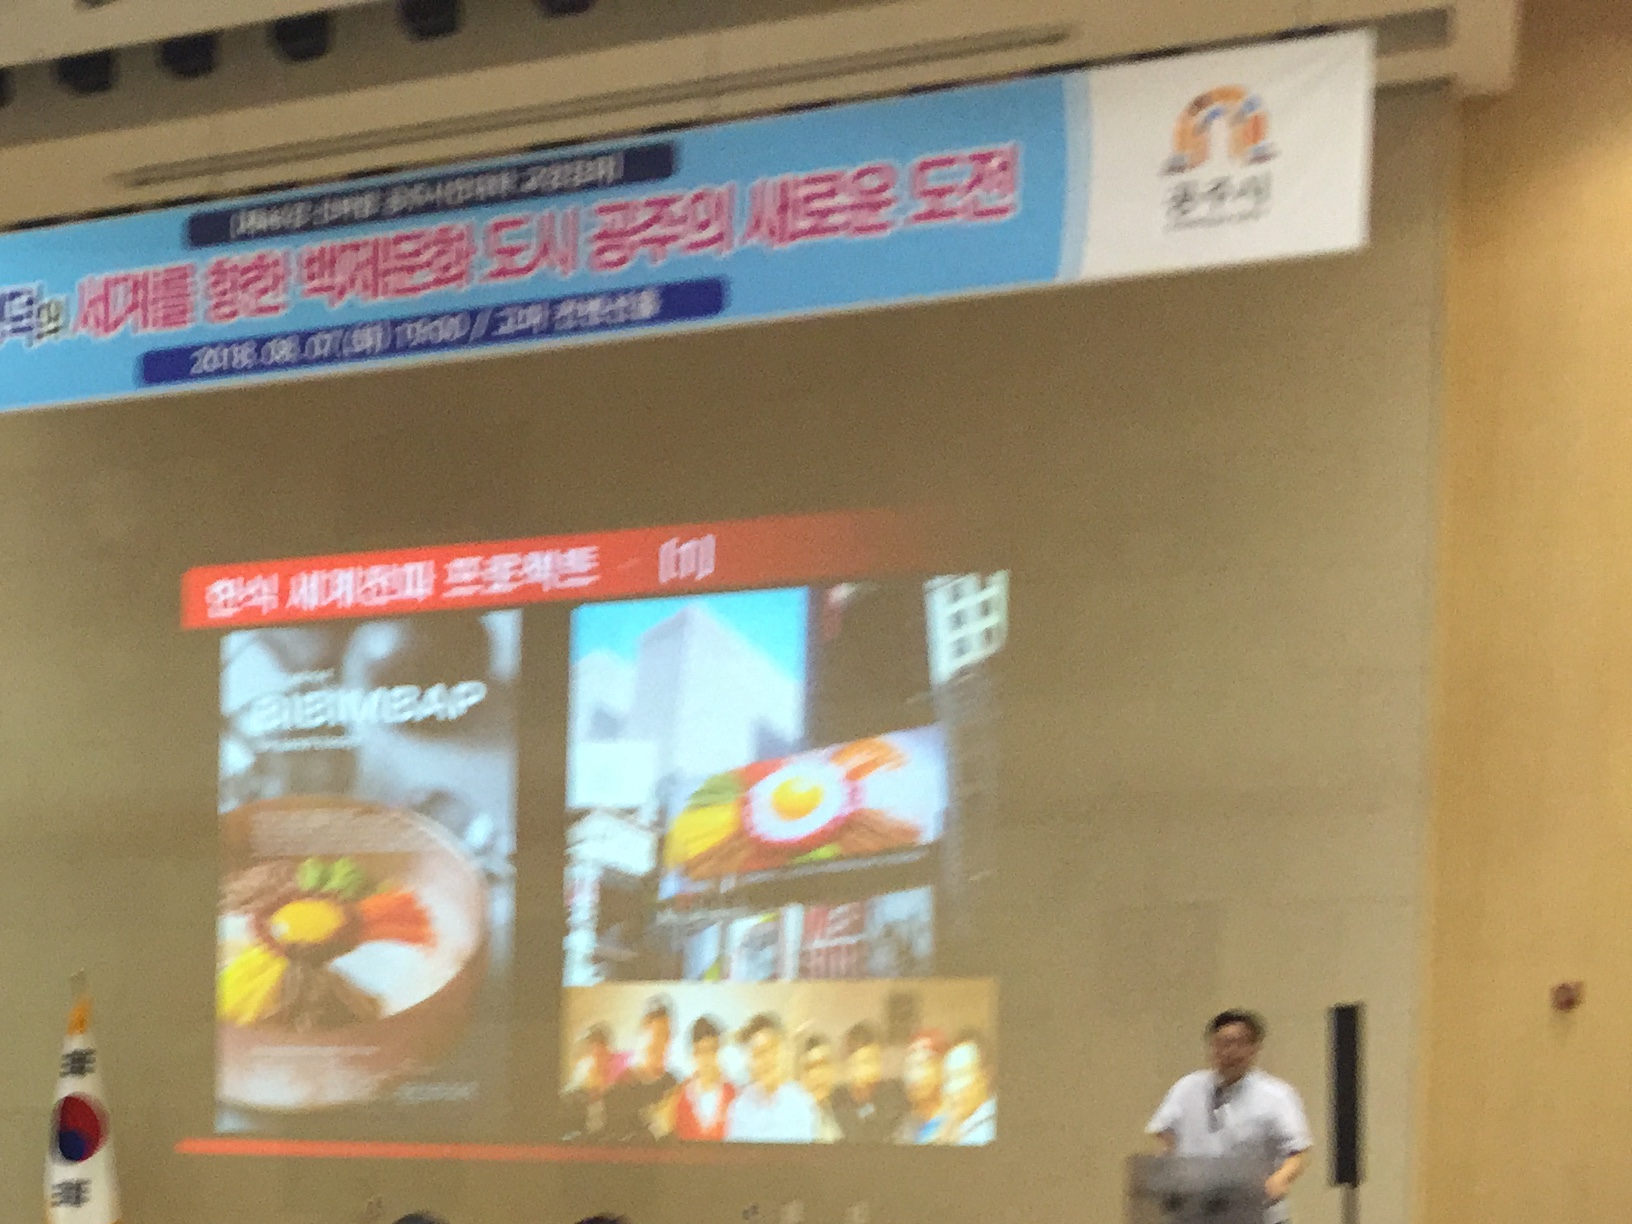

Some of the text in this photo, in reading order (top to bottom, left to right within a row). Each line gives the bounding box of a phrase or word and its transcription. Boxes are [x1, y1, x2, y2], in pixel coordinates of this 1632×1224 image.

[73, 262, 194, 337] 세계를
[205, 250, 288, 323] 향한
[301, 224, 472, 307] 백제문화
[484, 207, 578, 282] 도시
[590, 184, 735, 272] 공주의
[743, 164, 896, 247] 새로운
[907, 142, 1020, 224] 도전
[206, 573, 279, 618] 한식
[443, 546, 600, 598] 프로젝트
[248, 681, 487, 735] BIBIMBAP
